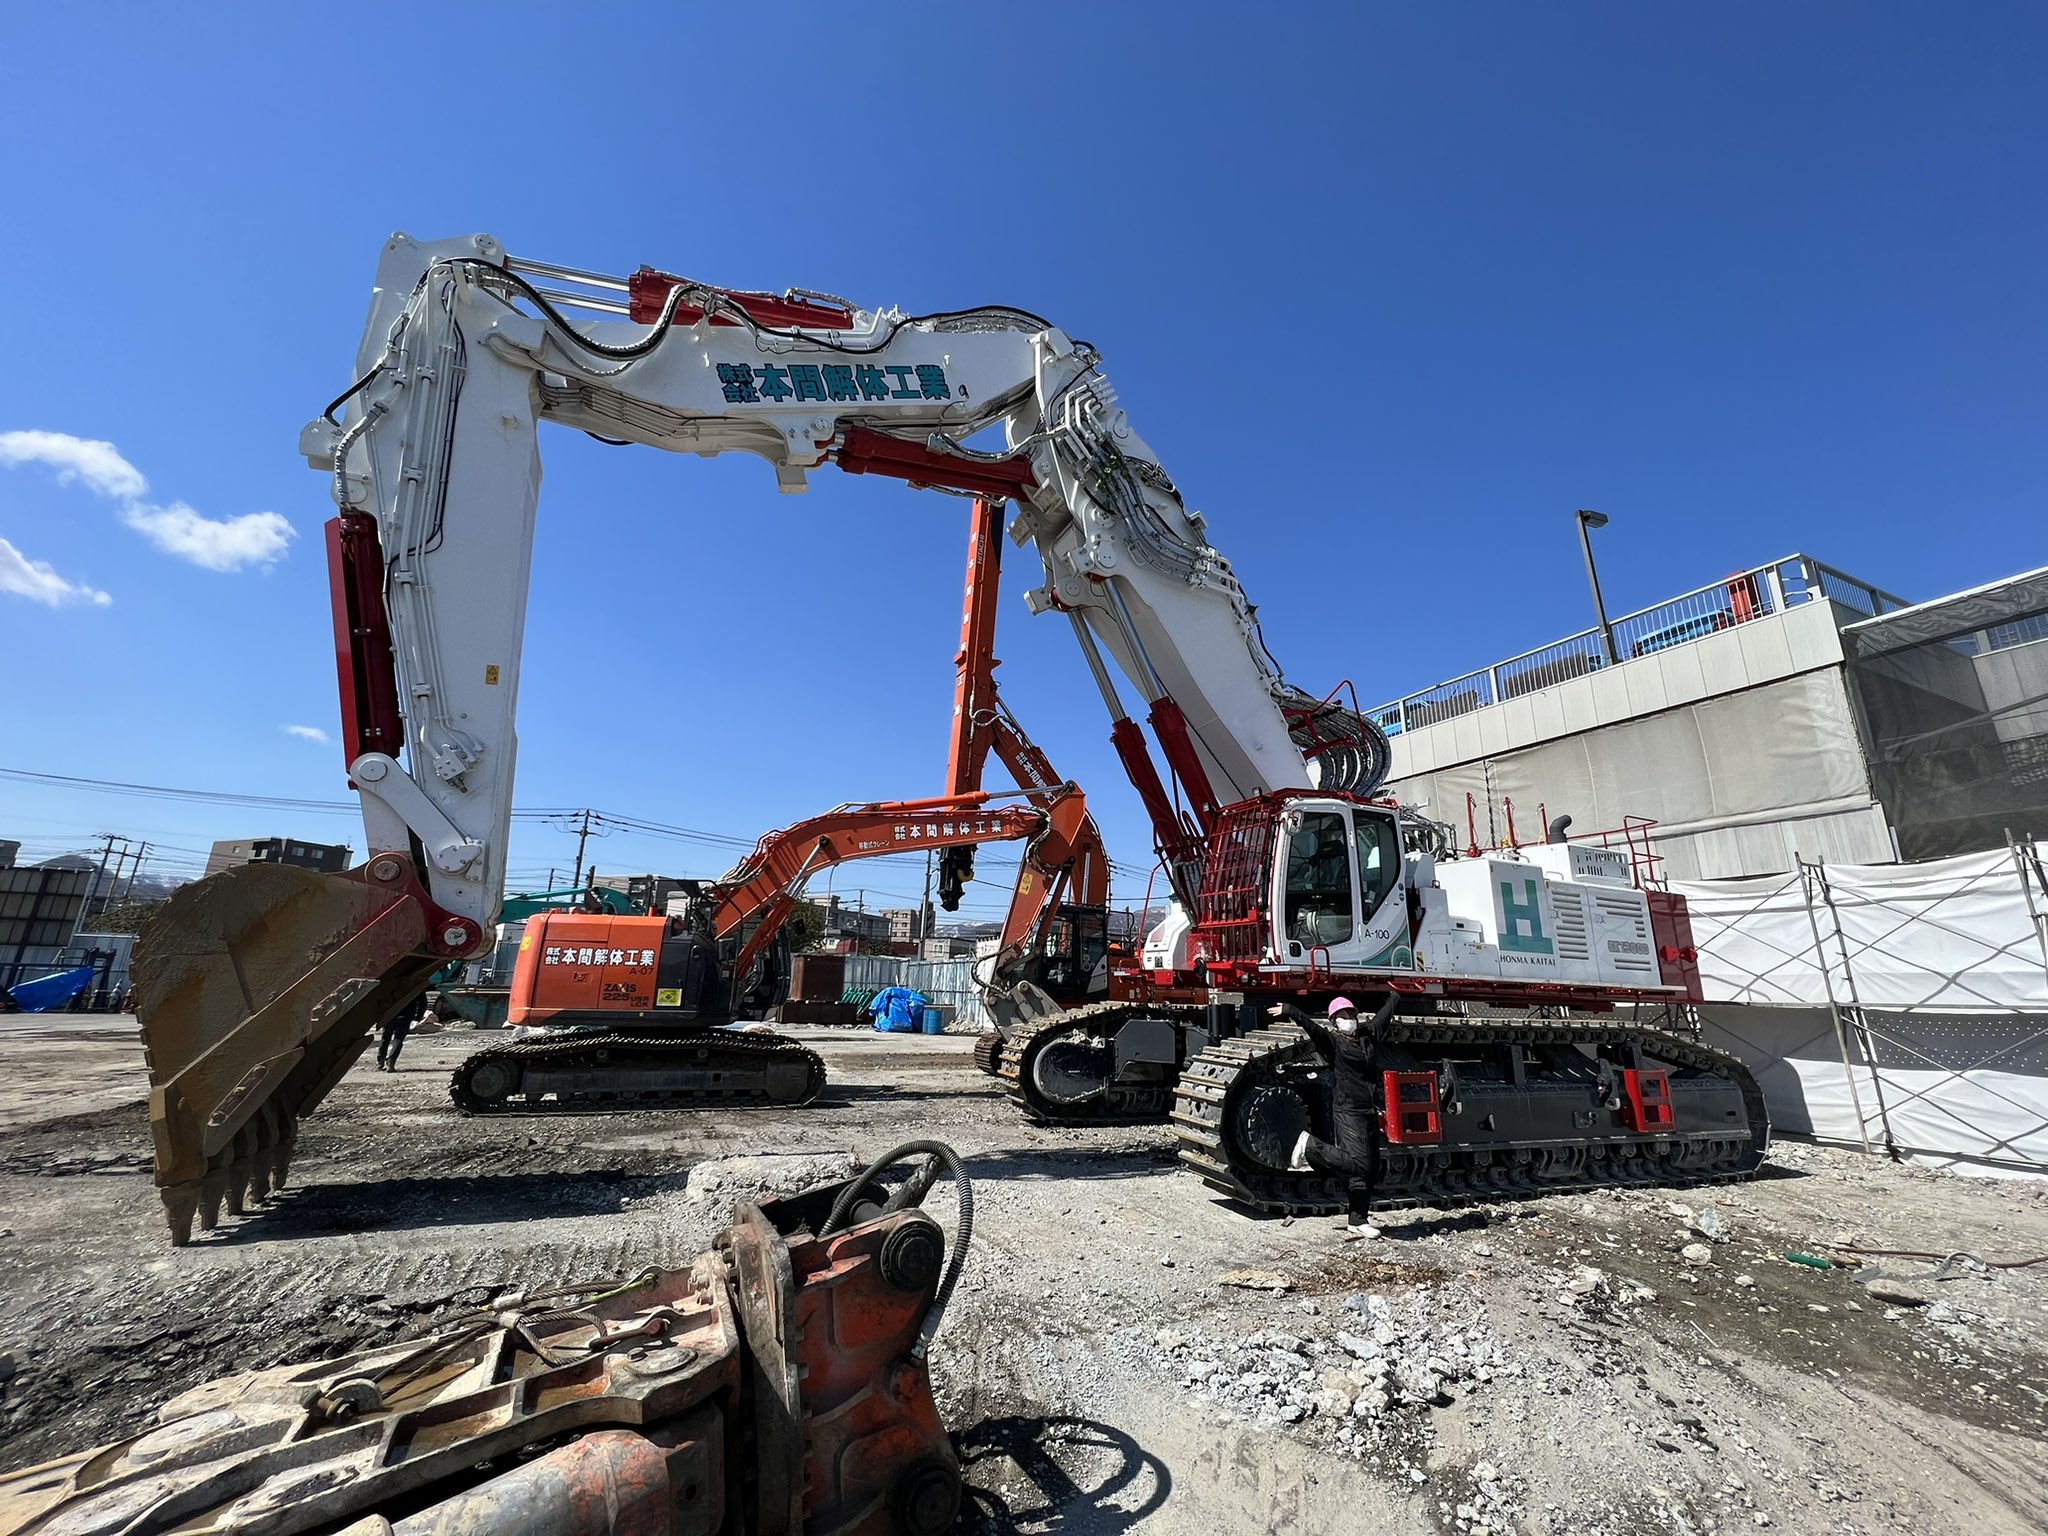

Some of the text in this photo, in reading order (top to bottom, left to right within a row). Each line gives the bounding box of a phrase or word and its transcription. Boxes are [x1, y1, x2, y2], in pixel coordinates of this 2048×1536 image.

[753, 363, 951, 403] 本間解体工業
[977, 534, 985, 565] HITACHI
[1364, 927, 1390, 941] A-100
[561, 948, 655, 966] 本間解体工業
[1500, 954, 1556, 966] HONMA KAITAI
[629, 967, 654, 976] A-07
[604, 984, 637, 993] ZAXIS
[602, 993, 631, 1001] 225
